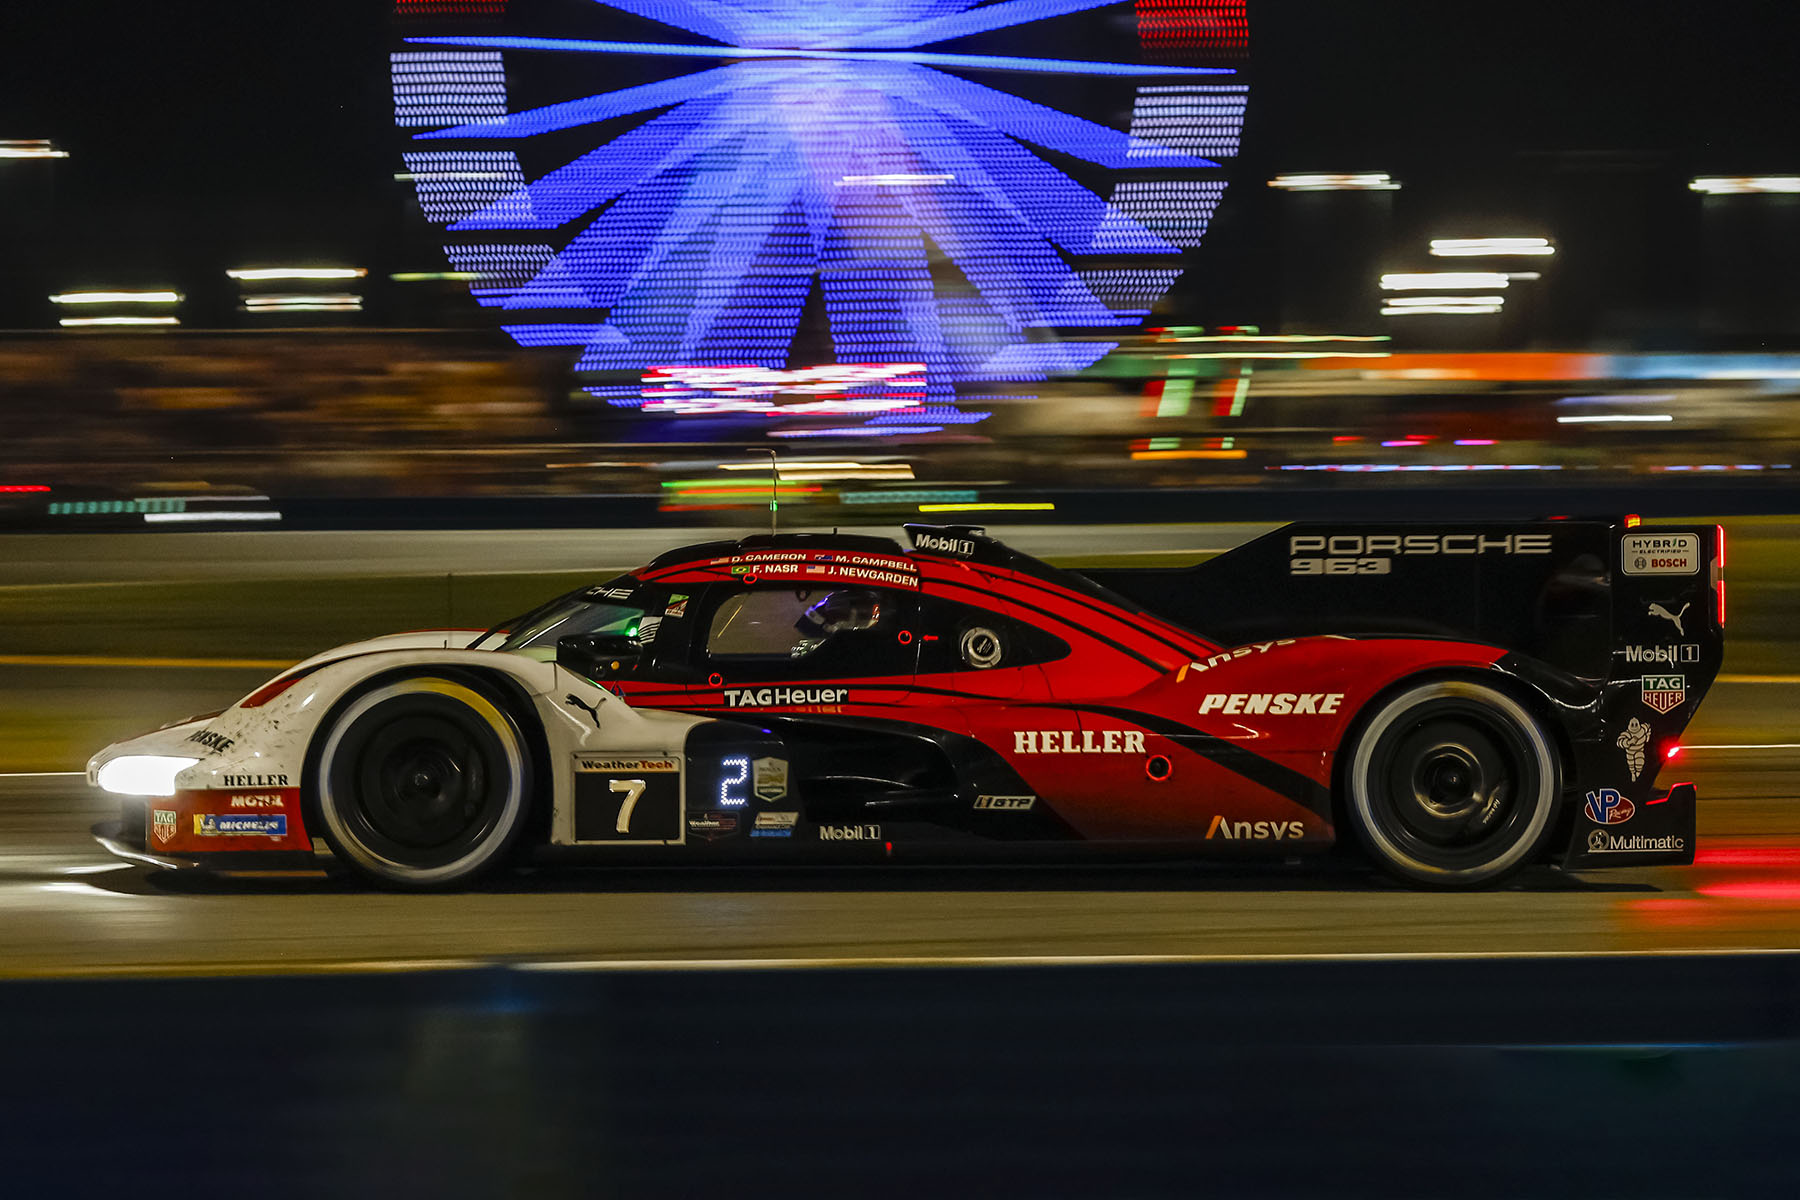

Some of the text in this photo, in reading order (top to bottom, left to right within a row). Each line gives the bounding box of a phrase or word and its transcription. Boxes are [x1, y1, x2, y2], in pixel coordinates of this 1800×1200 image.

[915, 533, 958, 553] Mobil
[1290, 534, 1552, 556] PORSCHE
[1632, 538, 1688, 549] HYBRID
[745, 553, 807, 561] CAMERON
[835, 555, 918, 572] M. CAMPBELL
[1290, 557, 1391, 574] 963
[1651, 558, 1688, 568] BOSCH
[752, 564, 799, 574] F. NASR
[828, 566, 919, 588] J. NEWGARDEN
[1625, 645, 1678, 662] Mobil
[1645, 677, 1682, 690] TAG
[1199, 693, 1344, 715] PENSKE
[1644, 692, 1683, 713] HEUER
[1013, 730, 1147, 753] HELLER
[580, 759, 674, 769] WeatherTech
[223, 774, 288, 786] HELLER
[720, 758, 748, 805] 2
[608, 779, 646, 833] 7
[1586, 788, 1621, 824] VP
[155, 811, 174, 823] TAG
[819, 825, 862, 840] Mobil
[1205, 814, 1304, 840] Ansys
[1610, 835, 1684, 850] Multimatic
